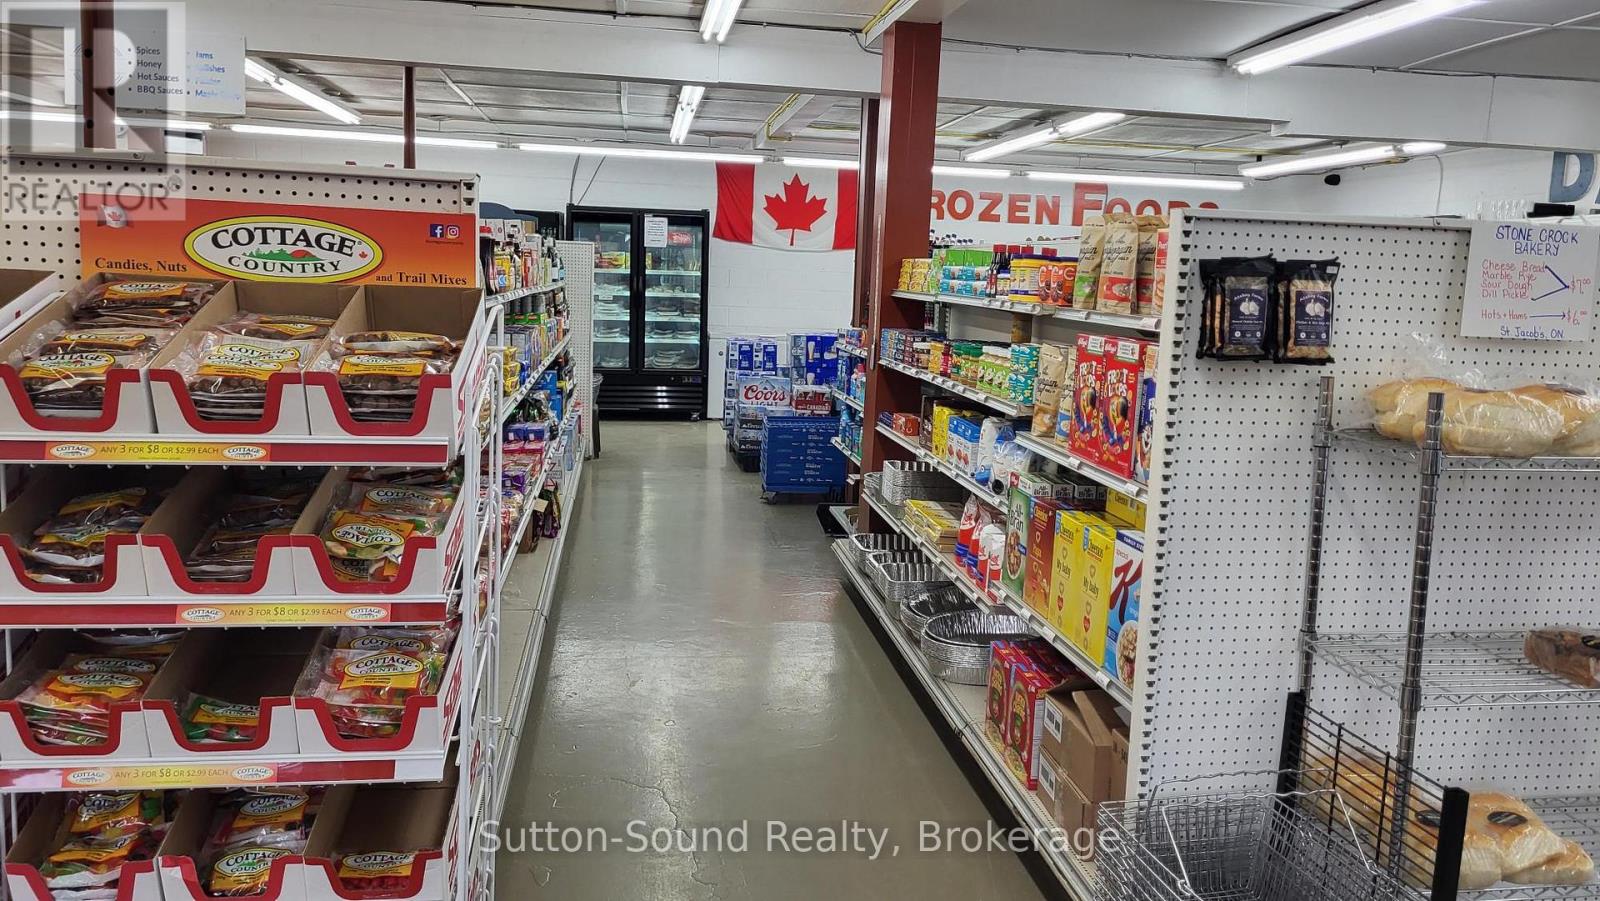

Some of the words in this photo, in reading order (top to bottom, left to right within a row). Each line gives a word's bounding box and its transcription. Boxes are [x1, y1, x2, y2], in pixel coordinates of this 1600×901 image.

[136, 47, 160, 56] Spices
[136, 60, 162, 69] Honey
[137, 73, 152, 81] Hot
[153, 74, 179, 82] Sauces
[137, 85, 155, 94] BBQ
[157, 86, 183, 95] Sauces
[1495, 225, 1534, 241] STONE
[1540, 228, 1578, 244] CROCK
[211, 227, 356, 257] COTTAGE
[1514, 241, 1560, 257] BAKERY
[95, 257, 152, 271] Candies,
[156, 260, 187, 272] Nuts
[228, 256, 341, 275] COUNTRY
[1482, 259, 1516, 271] Cheese
[1522, 261, 1546, 273] Bread
[375, 273, 392, 283] and
[396, 271, 427, 285] Trail
[430, 273, 467, 286] Mixes
[1482, 271, 1512, 280] Marble
[1519, 271, 1537, 281] Rye
[1481, 281, 1502, 289] Sour
[1507, 280, 1533, 292] Dough
[1482, 289, 1498, 298] Dill
[1502, 289, 1529, 299] Pickle
[1481, 309, 1501, 320] Hots
[1508, 309, 1528, 320] Hams
[1550, 329, 1564, 339] ON
[743, 384, 785, 402] Coors
[101, 446, 118, 454] ANY
[119, 444, 126, 454] 3
[128, 446, 144, 454] FOR
[147, 444, 159, 454] $8
[175, 446, 196, 454] $2.99
[1062, 563, 1071, 579] baby
[1089, 580, 1099, 599] baby
[1109, 559, 1144, 625] K
[248, 606, 254, 616] 3
[273, 606, 286, 616] $8
[322, 608, 342, 616] EACH
[355, 656, 413, 669] COTTAGE
[133, 768, 139, 778] 3
[159, 768, 171, 777] $8
[173, 769, 185, 777] OR
[187, 769, 206, 777] $2.99
